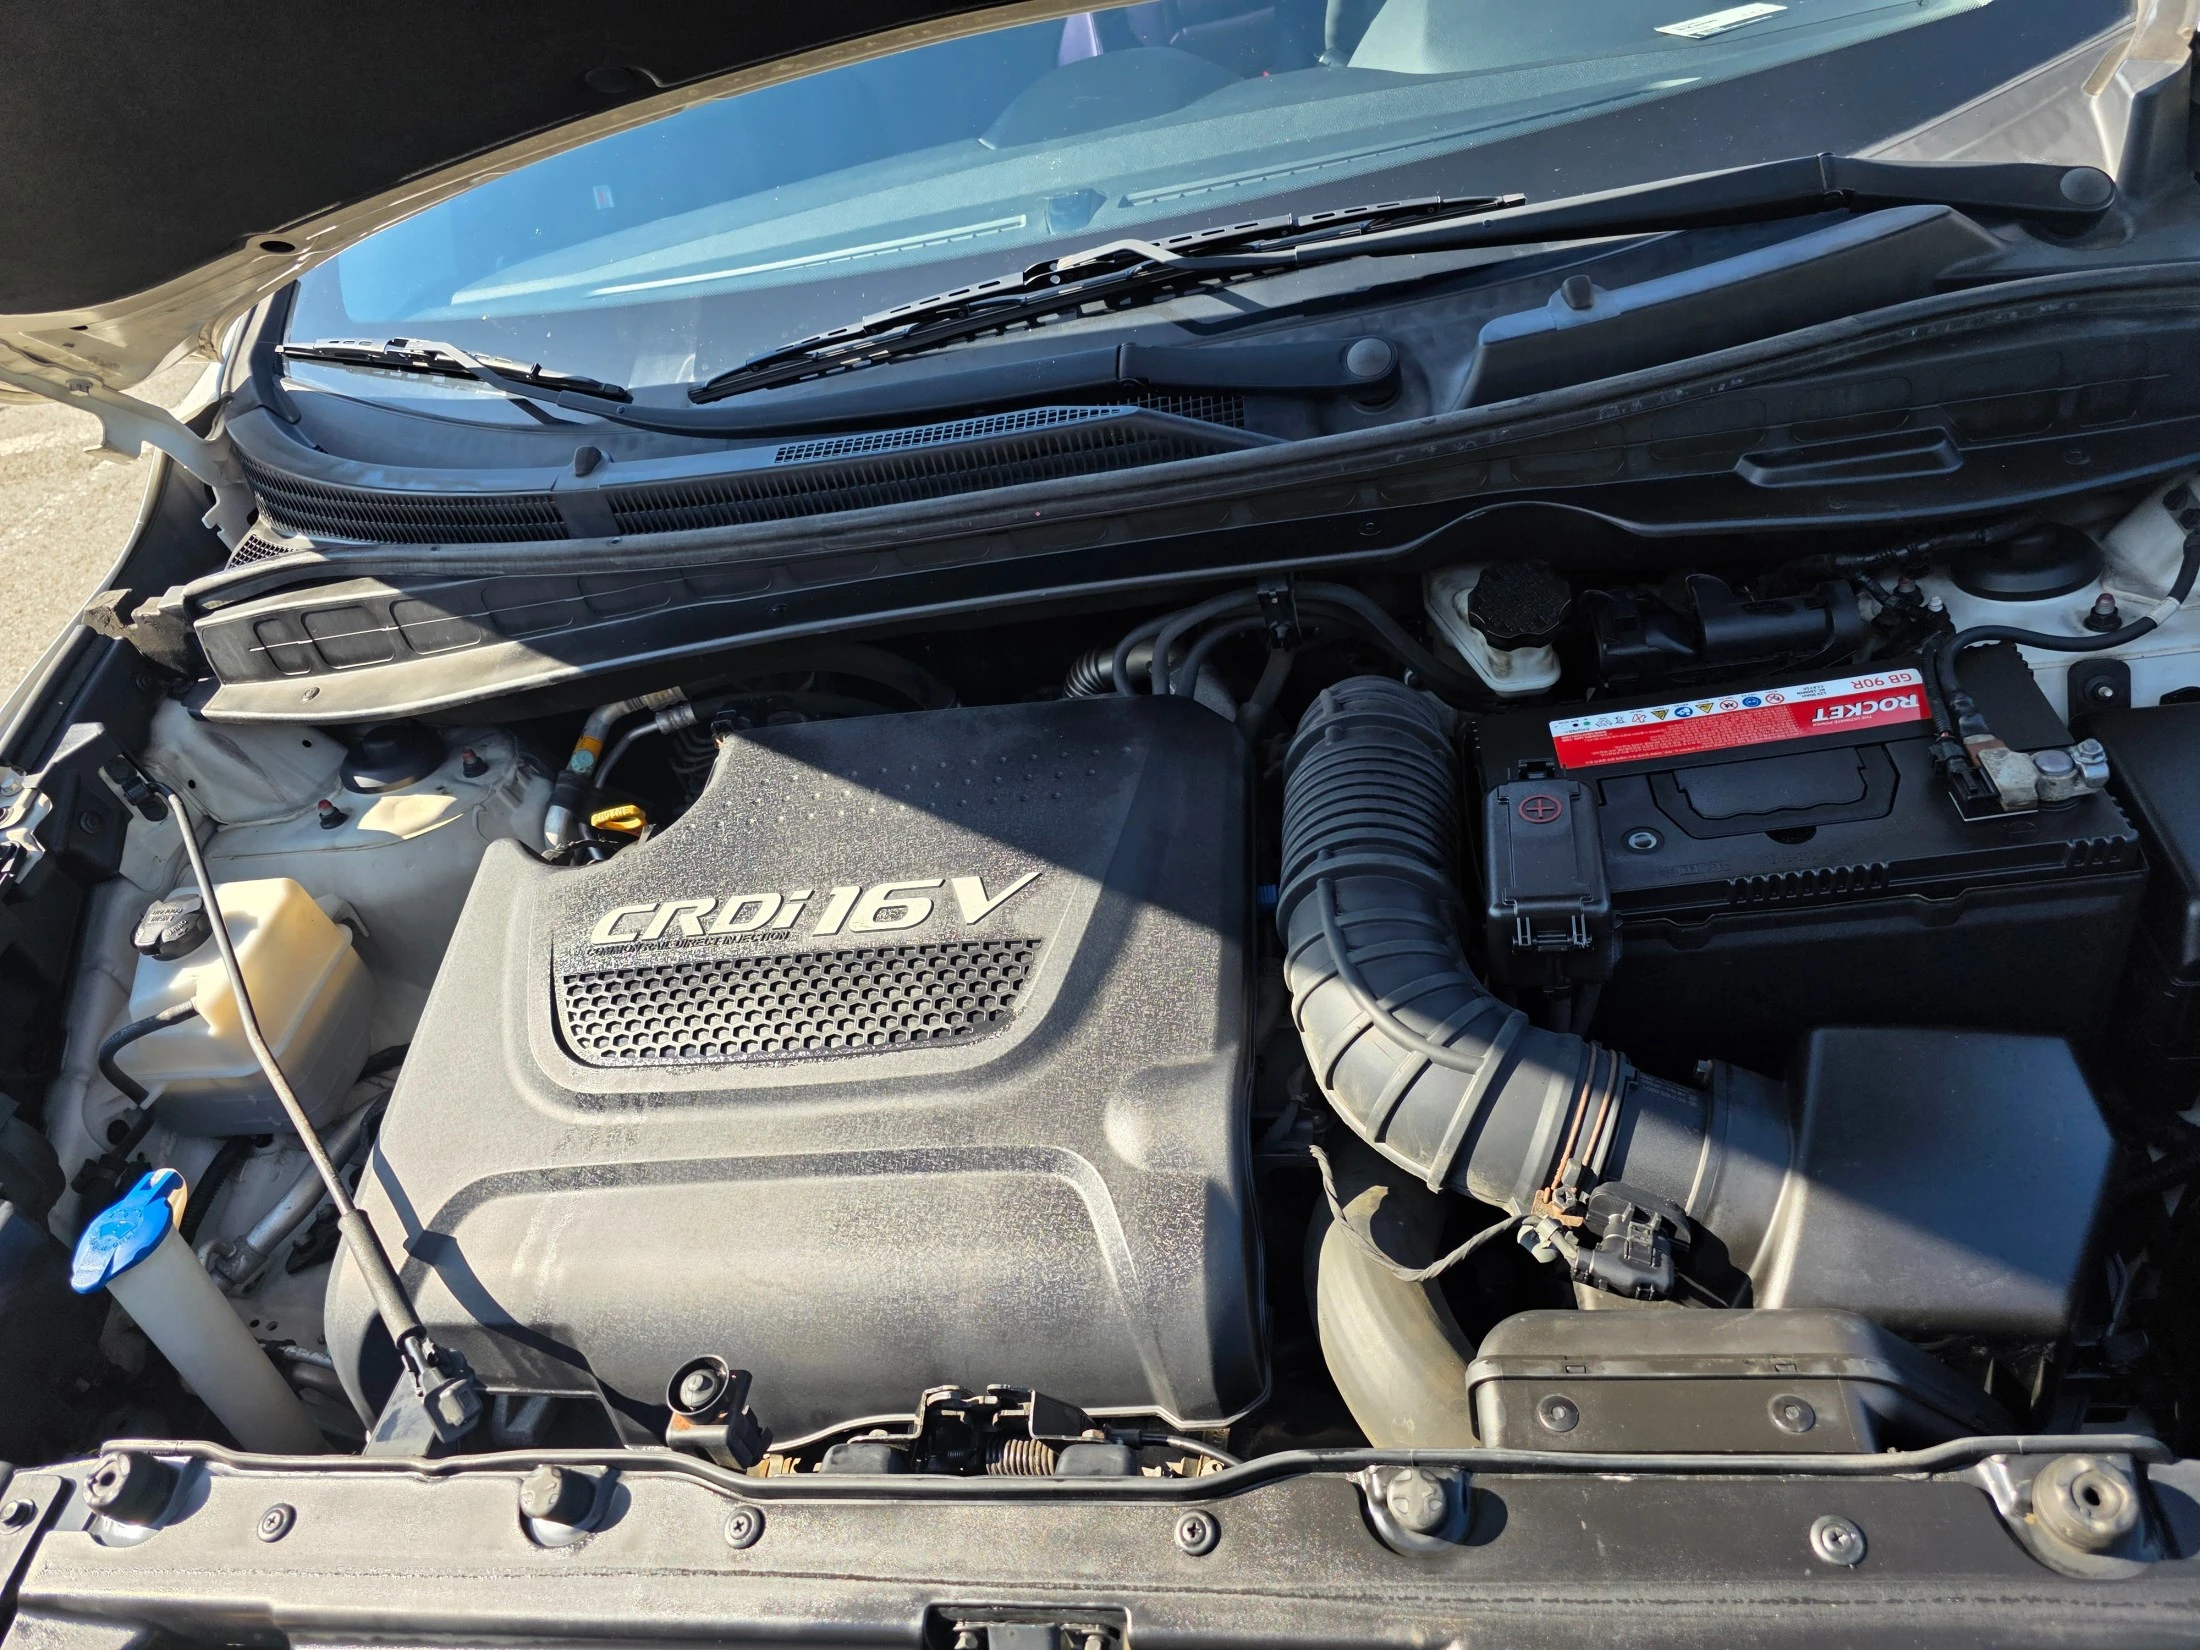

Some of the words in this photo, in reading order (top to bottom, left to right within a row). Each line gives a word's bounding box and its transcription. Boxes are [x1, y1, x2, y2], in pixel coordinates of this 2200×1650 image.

[1851, 677, 1885, 690] 90R
[1888, 673, 1912, 684] GB
[1811, 694, 1920, 723] ROCKET
[590, 888, 815, 945] CRDi
[586, 943, 643, 957] COMMON
[644, 940, 671, 952] RAIL
[674, 936, 718, 949] DIRECT
[719, 930, 792, 946] INJECTION
